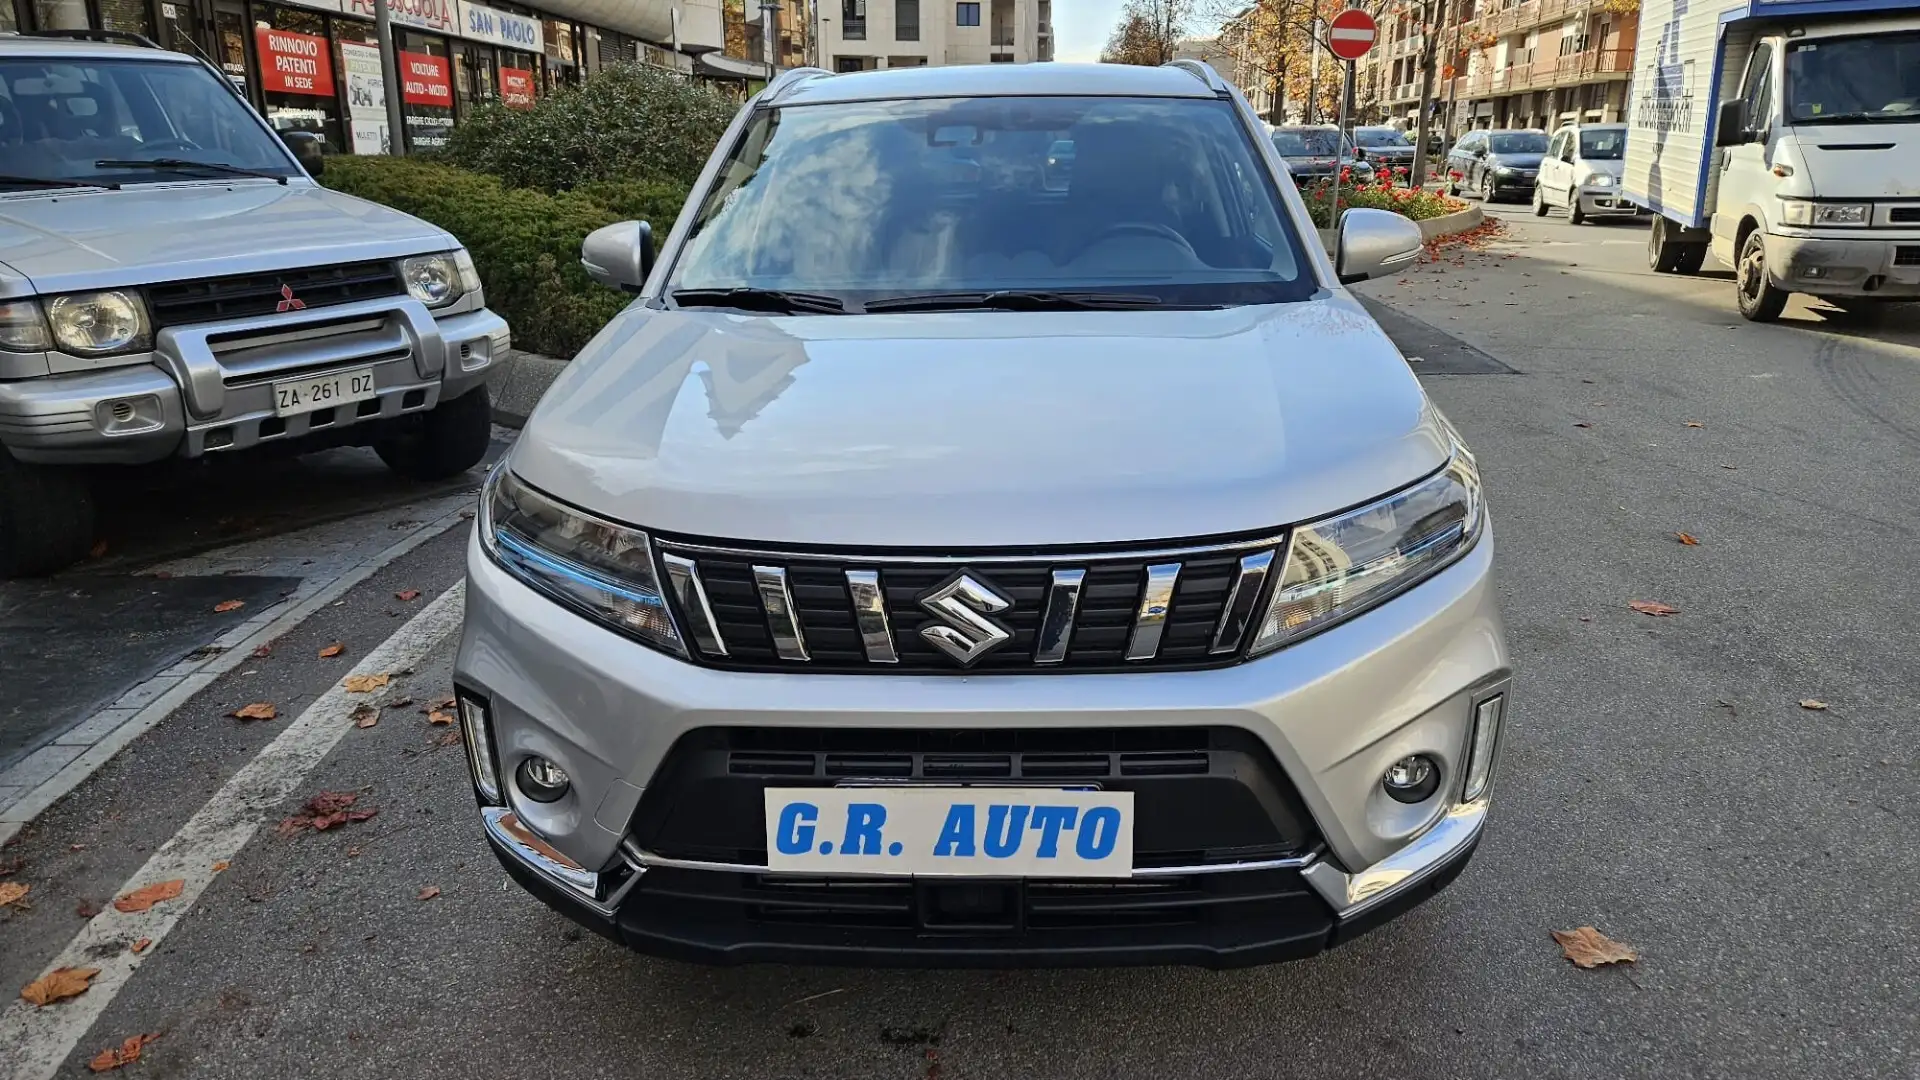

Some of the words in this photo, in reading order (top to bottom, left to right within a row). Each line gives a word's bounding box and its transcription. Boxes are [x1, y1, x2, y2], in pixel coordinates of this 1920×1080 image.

[469, 10, 493, 36] SAN
[500, 16, 535, 44] PAOLO
[269, 34, 318, 57] RINNOVO
[275, 55, 317, 75] PATENTI
[410, 62, 439, 77] VOLTURE
[284, 76, 294, 88] IN
[294, 76, 313, 89] SEDE
[405, 81, 424, 94] AUTO
[428, 82, 448, 96] MOTO
[278, 389, 300, 408] ZA
[311, 381, 340, 402] 261
[352, 375, 371, 394] DZ
[776, 802, 903, 857] G.R.
[933, 804, 1121, 860] AUTO
